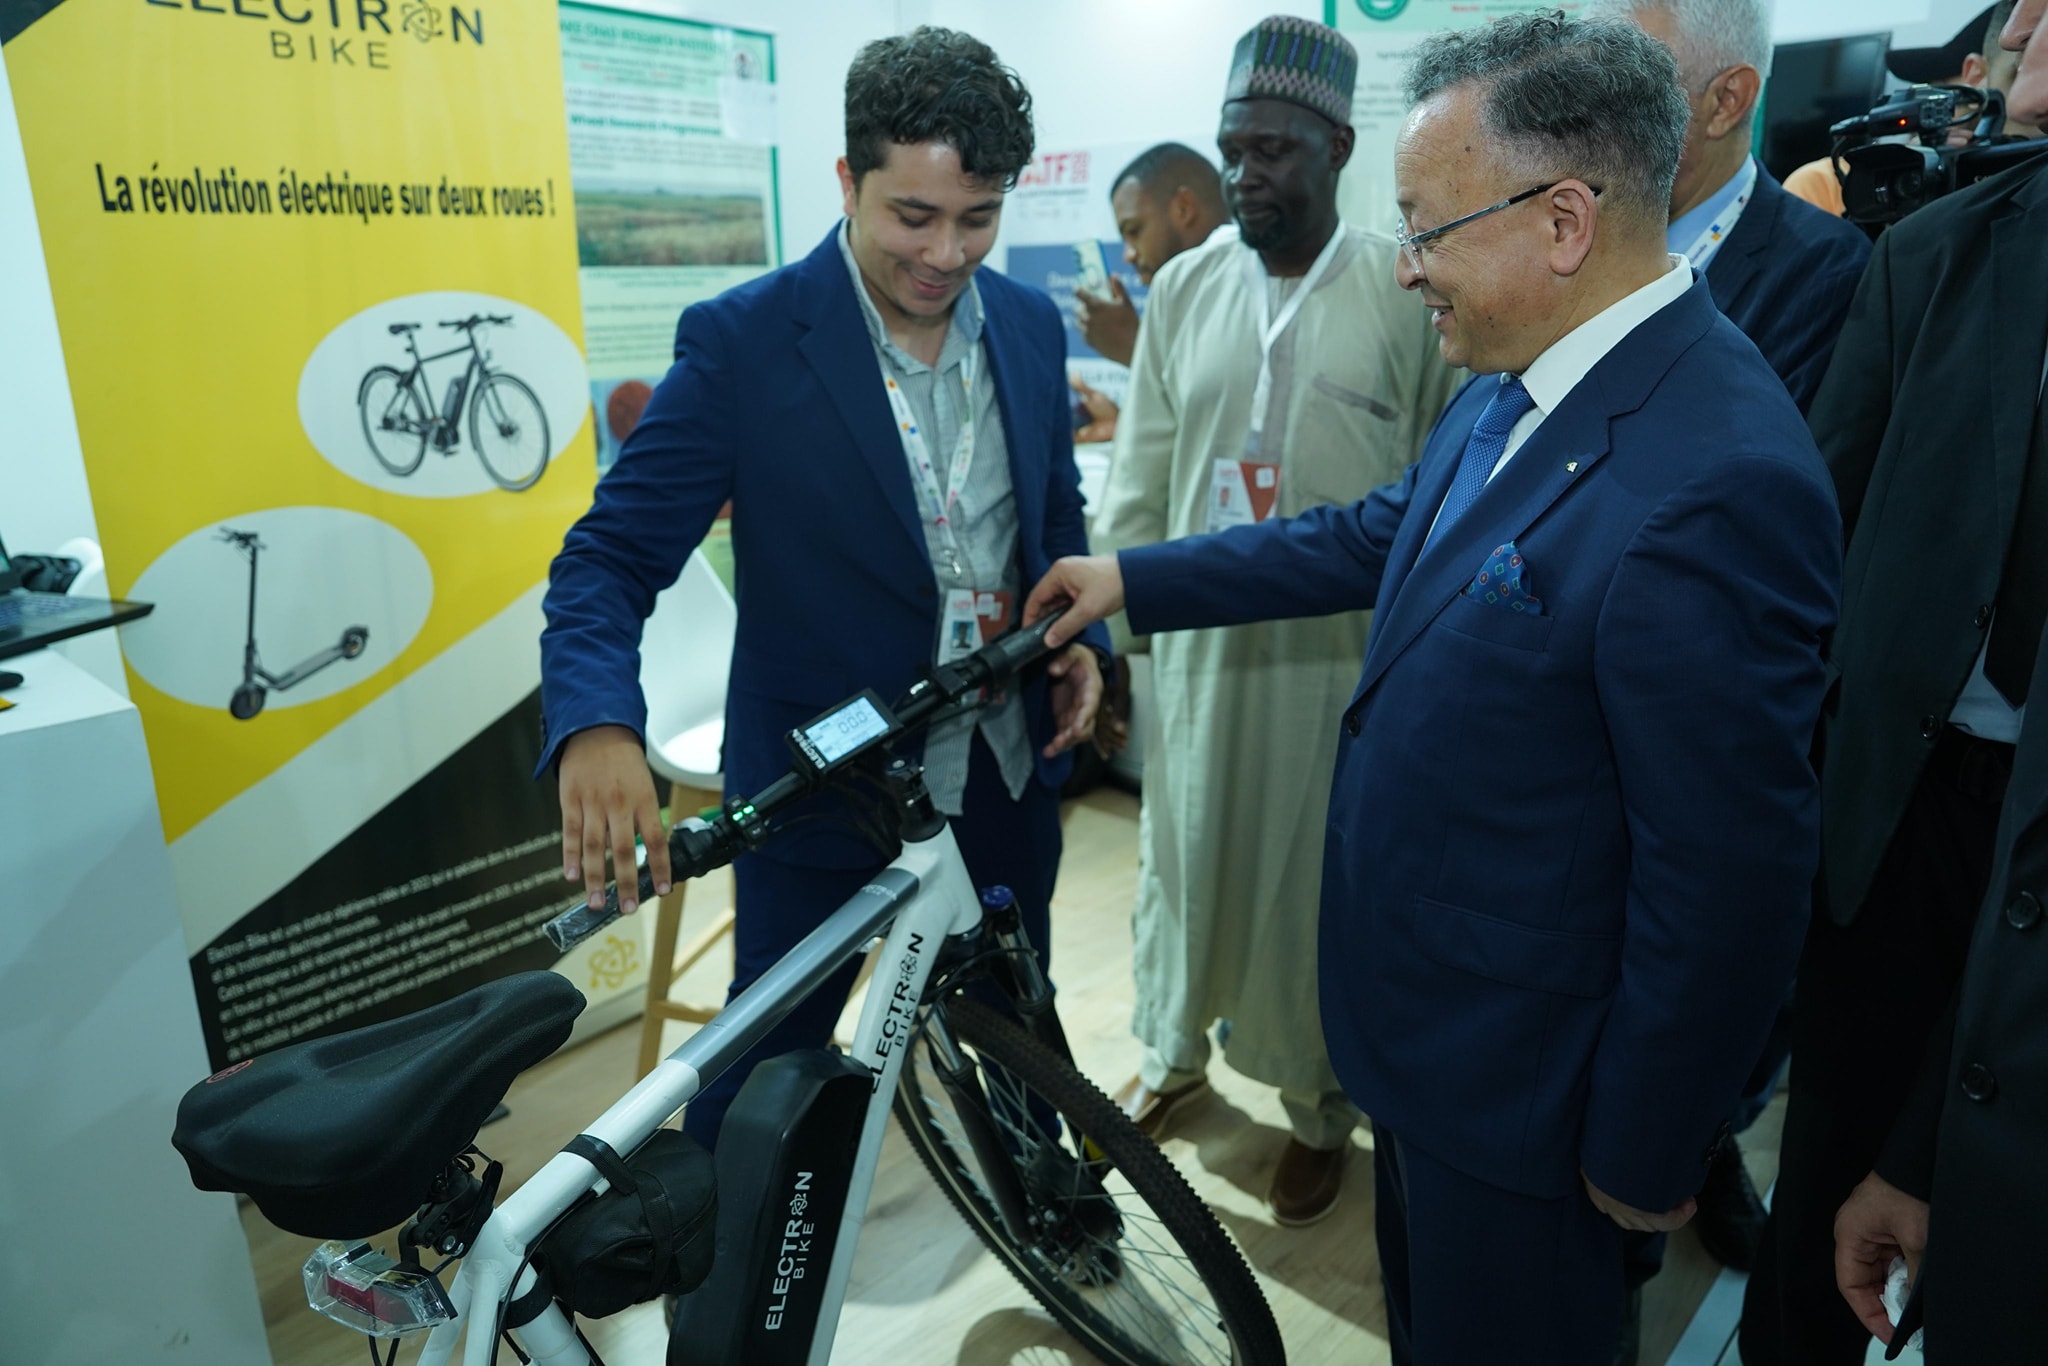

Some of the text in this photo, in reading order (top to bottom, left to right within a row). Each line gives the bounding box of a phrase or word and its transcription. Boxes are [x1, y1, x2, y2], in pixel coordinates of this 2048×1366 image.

[146, 0, 484, 45] ECTRON
[270, 31, 390, 70] BIKE
[95, 161, 556, 225] La révolution électrique sur deux roues !
[894, 990, 920, 1048] BIKE
[765, 1171, 813, 1331] ELECTRON
[792, 1222, 815, 1280] BIKE
